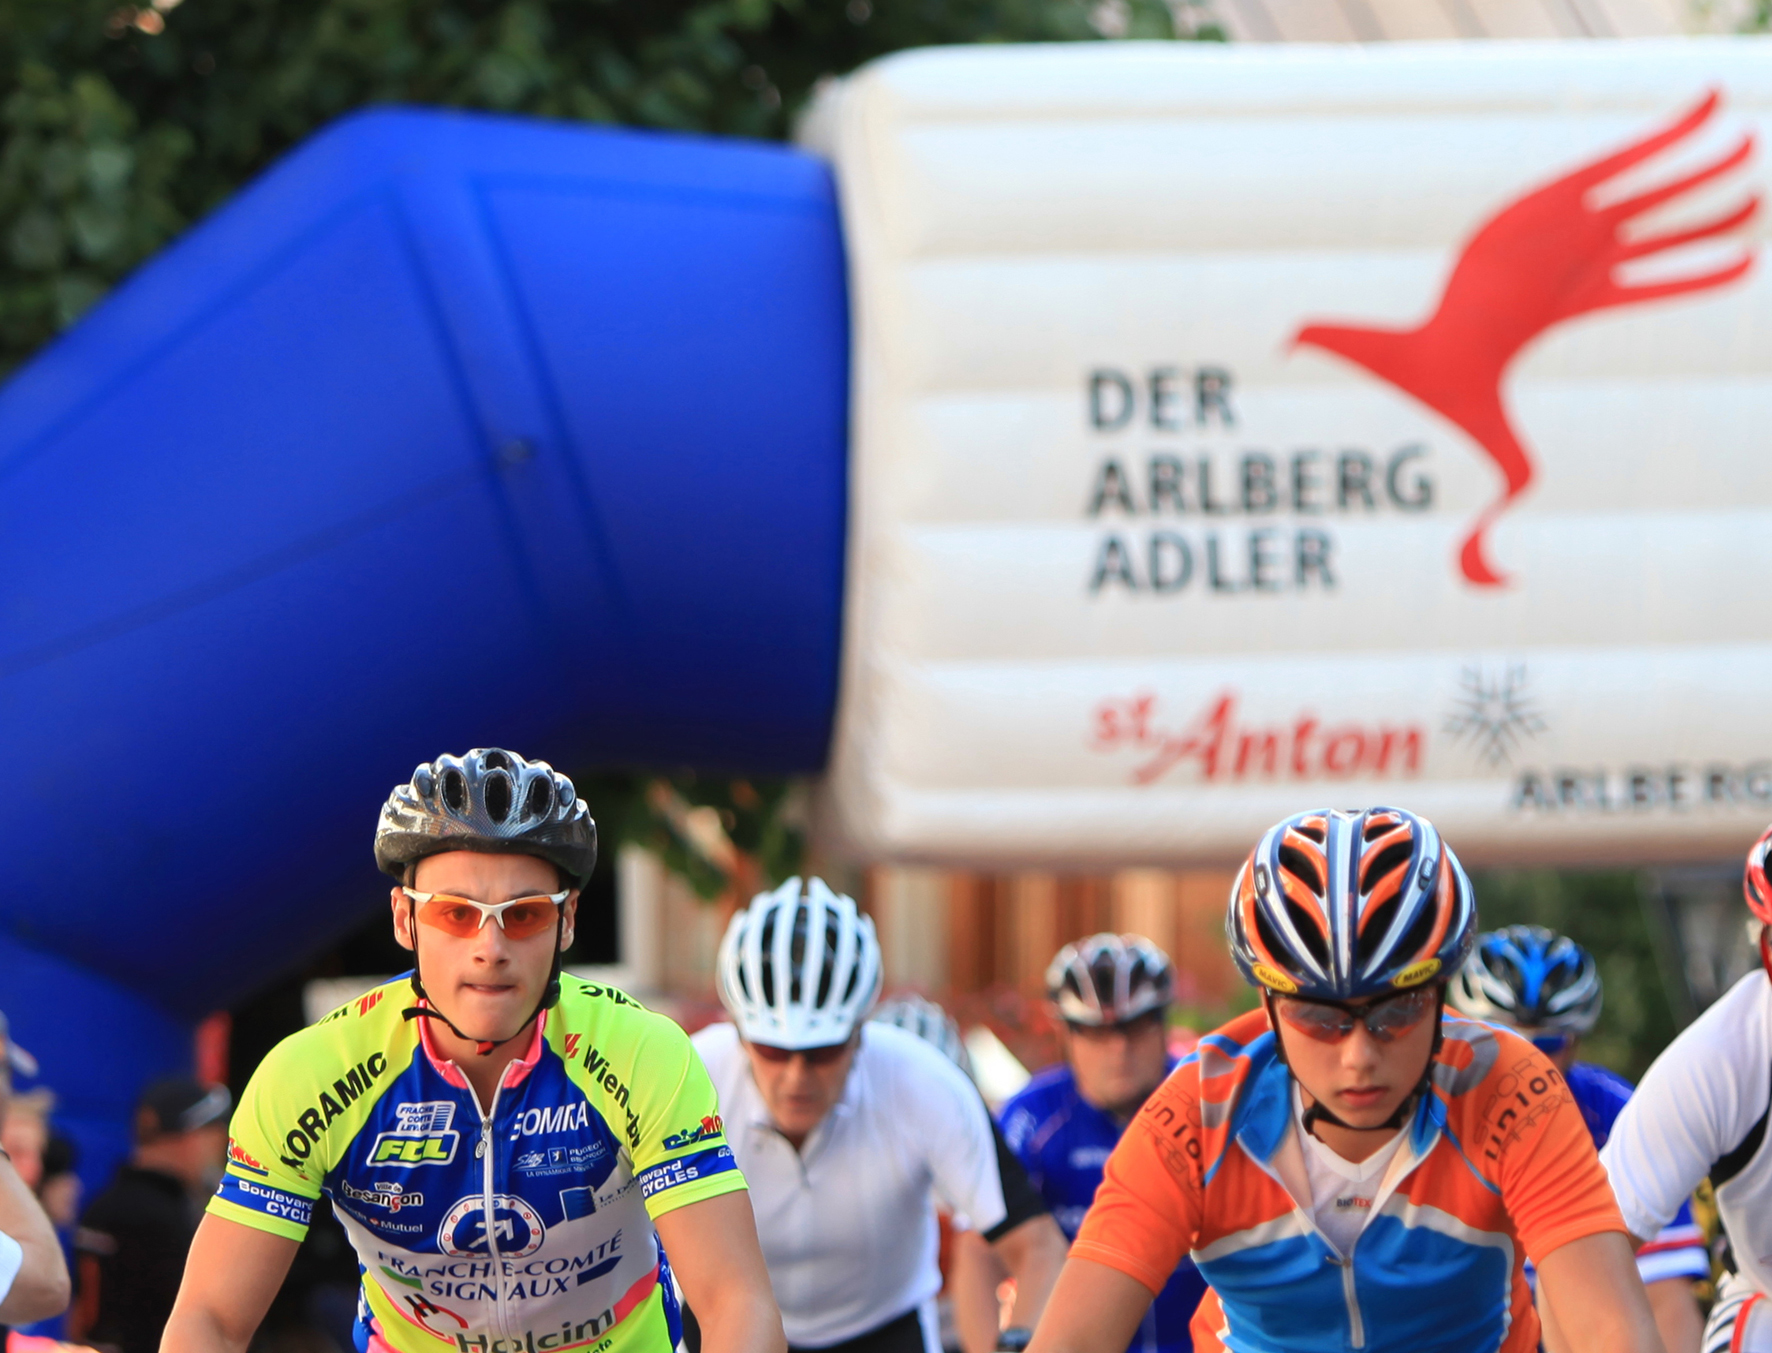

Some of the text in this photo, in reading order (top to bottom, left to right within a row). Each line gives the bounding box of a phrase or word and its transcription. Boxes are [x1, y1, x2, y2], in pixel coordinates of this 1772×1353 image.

[1085, 369, 1237, 433] DER
[1083, 446, 1437, 520] ARLBERG
[1085, 530, 1339, 596] ADLER
[1258, 970, 1288, 989] MAVIC
[1403, 964, 1435, 982] MAVIC
[642, 1166, 699, 1198] CYCLES
[380, 1221, 423, 1232] Mutuel
